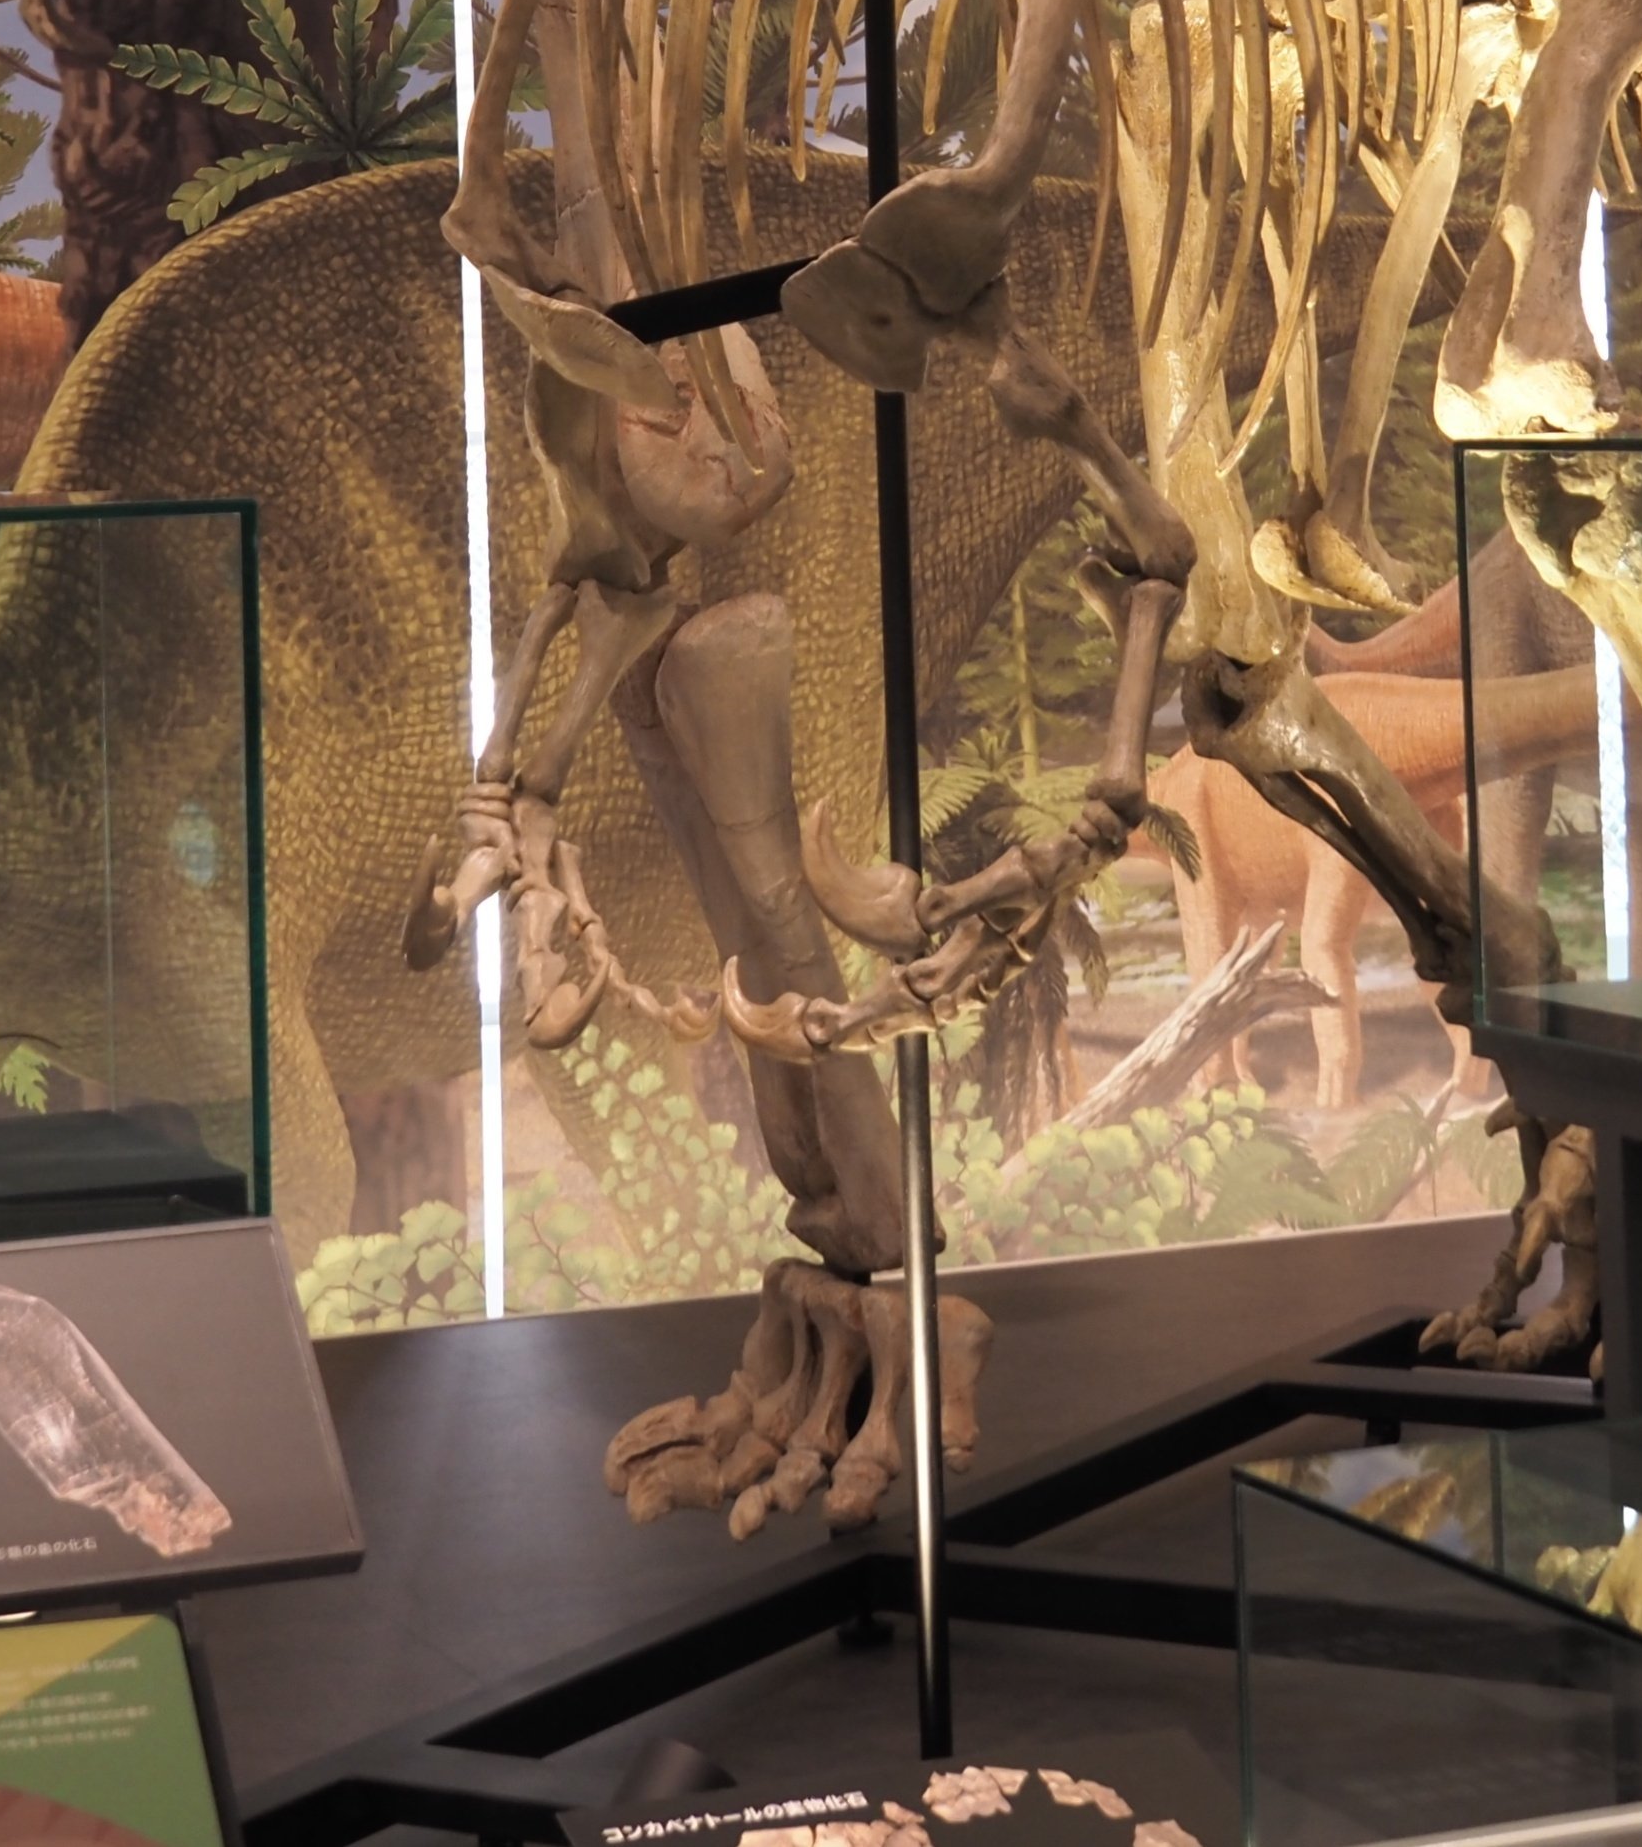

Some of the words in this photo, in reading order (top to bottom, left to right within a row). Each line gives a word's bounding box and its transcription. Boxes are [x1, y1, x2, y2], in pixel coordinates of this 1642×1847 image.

[602, 1790, 868, 1844] コンカベナトールの実物化石
